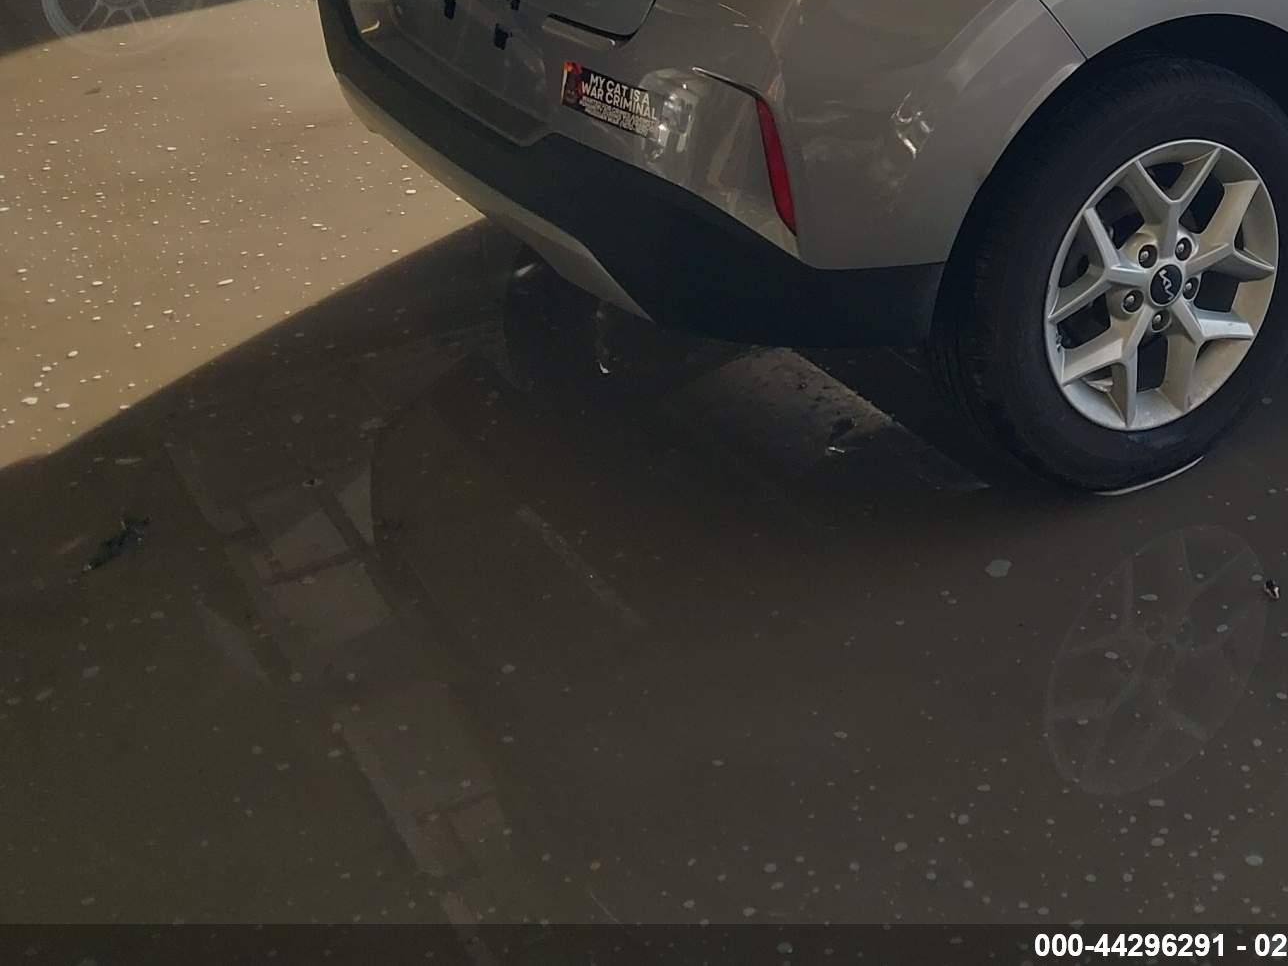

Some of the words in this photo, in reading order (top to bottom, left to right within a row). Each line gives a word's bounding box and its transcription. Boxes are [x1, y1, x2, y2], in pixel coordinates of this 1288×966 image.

[581, 81, 604, 101] WAR
[605, 91, 657, 120] CRIMINAL
[590, 73, 606, 87] MY
[606, 80, 628, 97] CAT
[630, 88, 641, 102] IS
[641, 93, 650, 105] A
